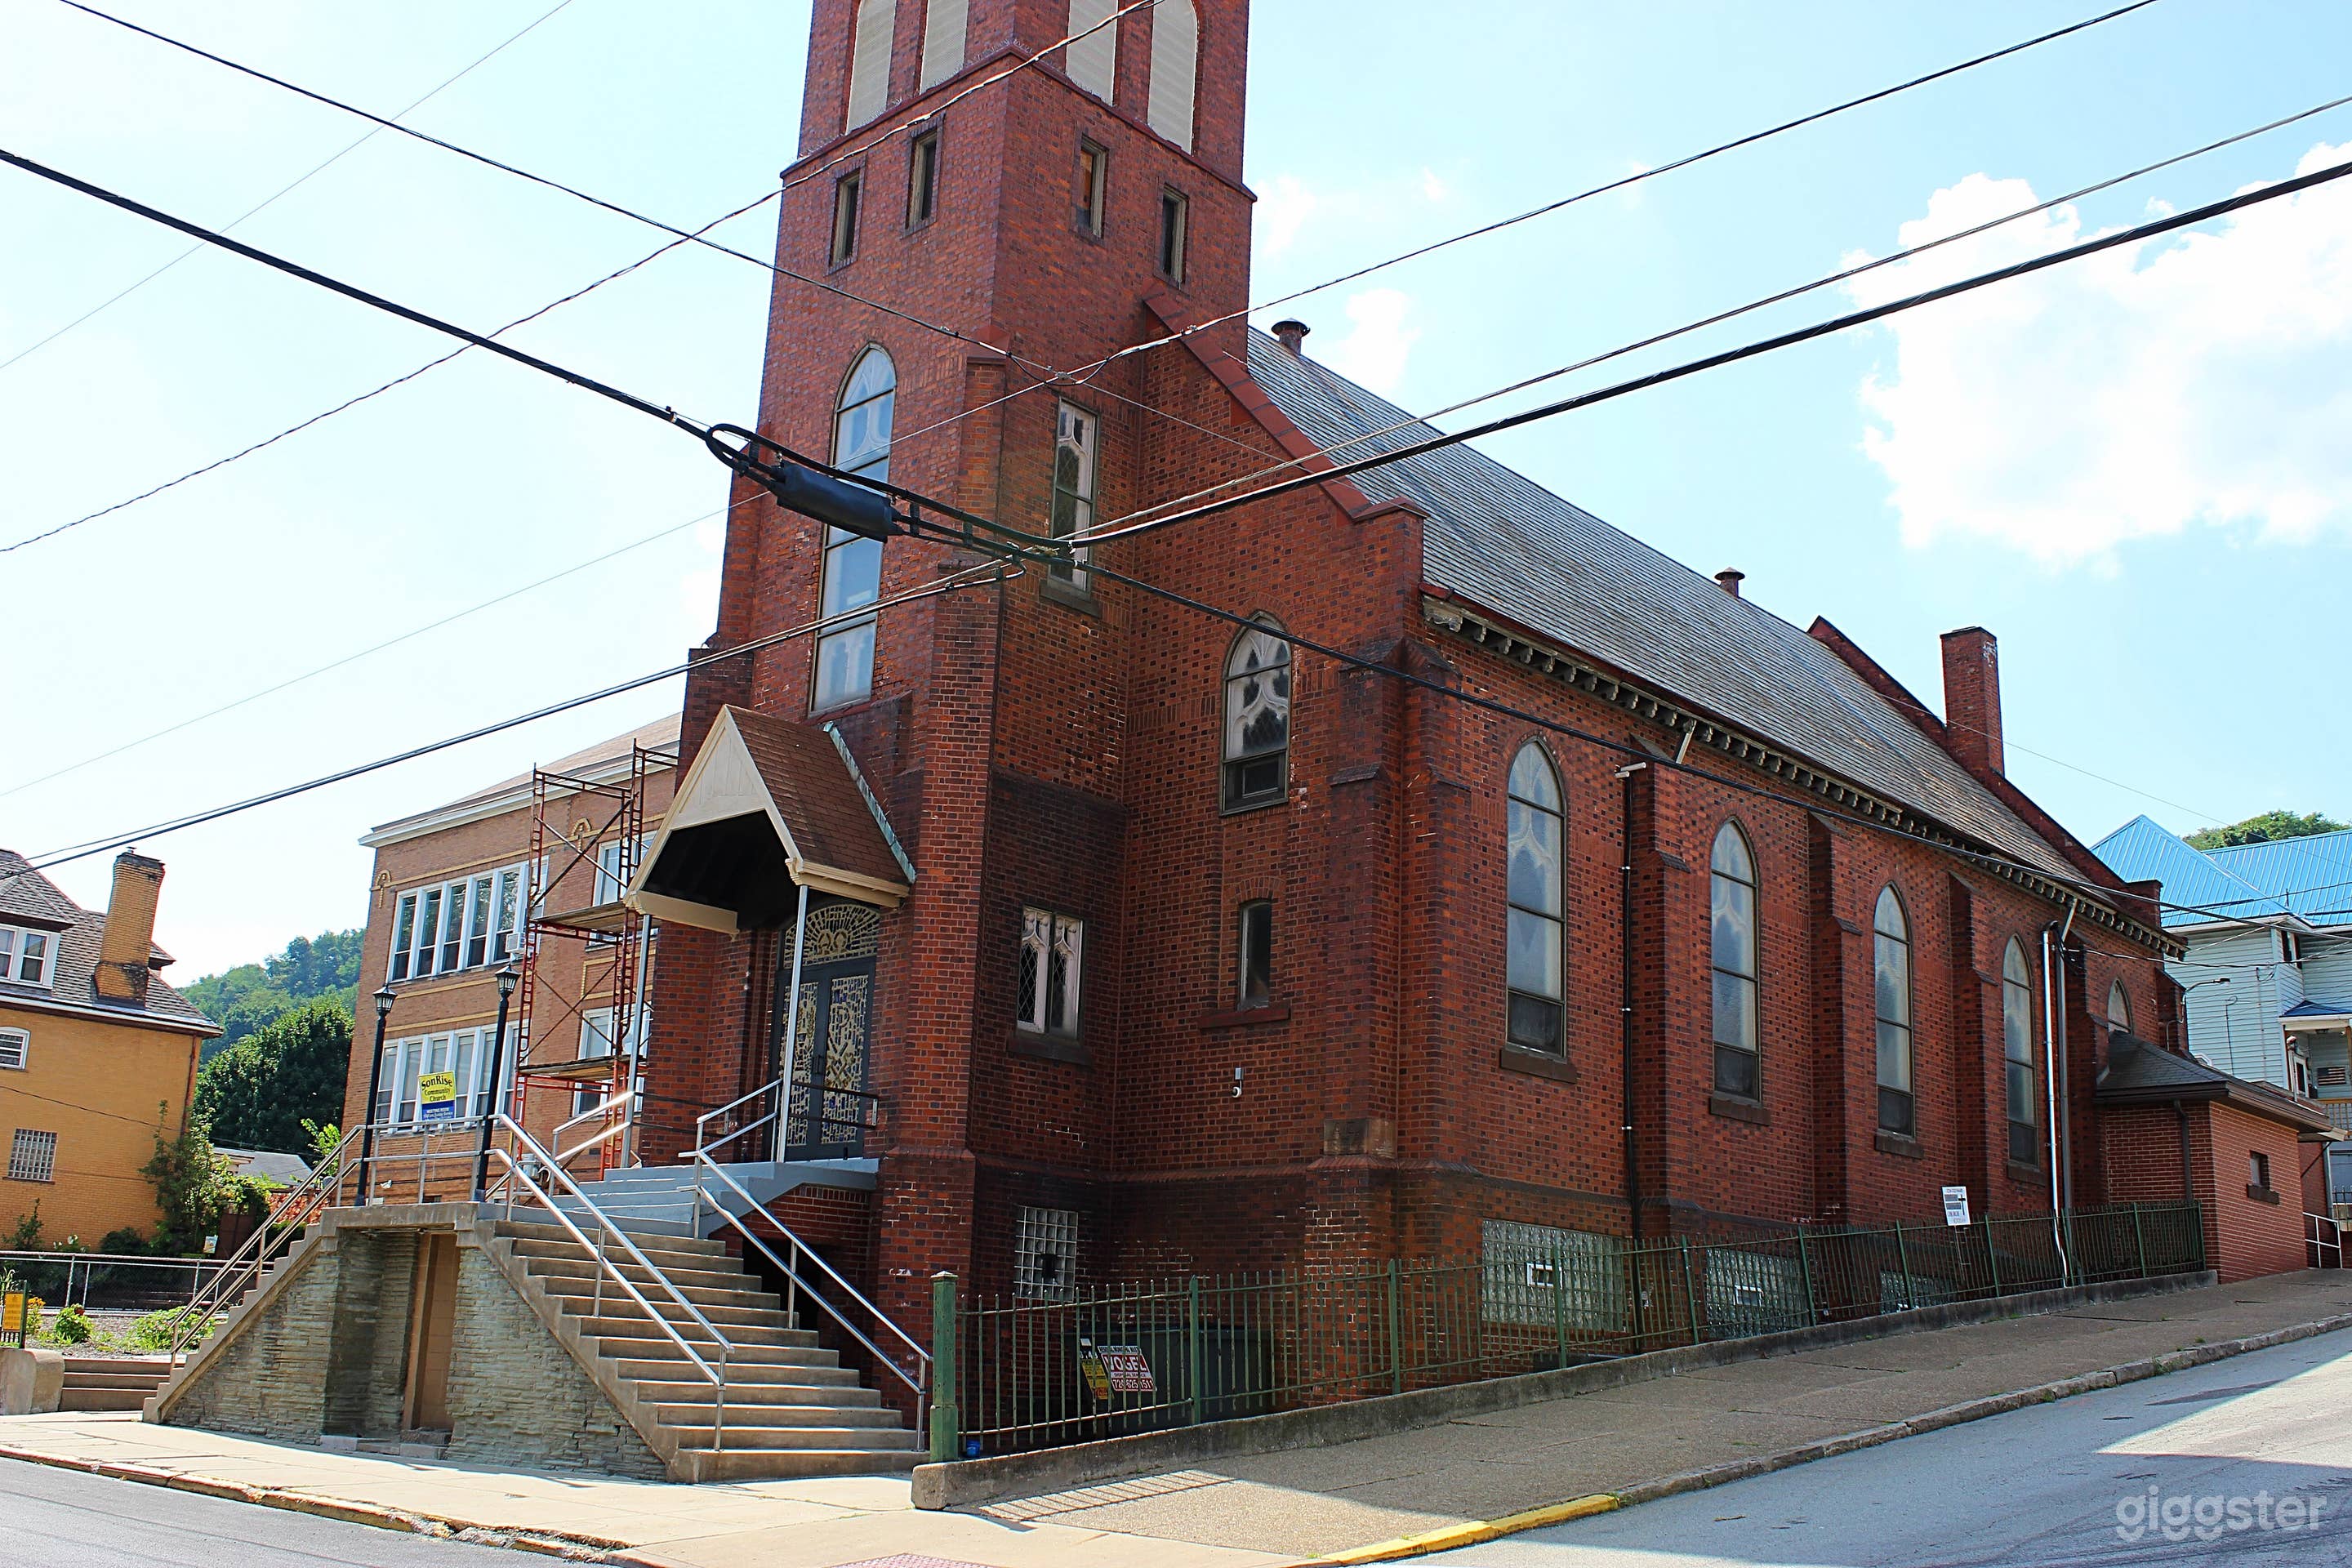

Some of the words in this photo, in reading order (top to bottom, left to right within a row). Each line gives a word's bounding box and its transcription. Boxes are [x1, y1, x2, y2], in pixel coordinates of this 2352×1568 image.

[421, 1075, 452, 1091] SonRise
[425, 1087, 450, 1096] Community
[1103, 1356, 1147, 1371] VOGEL
